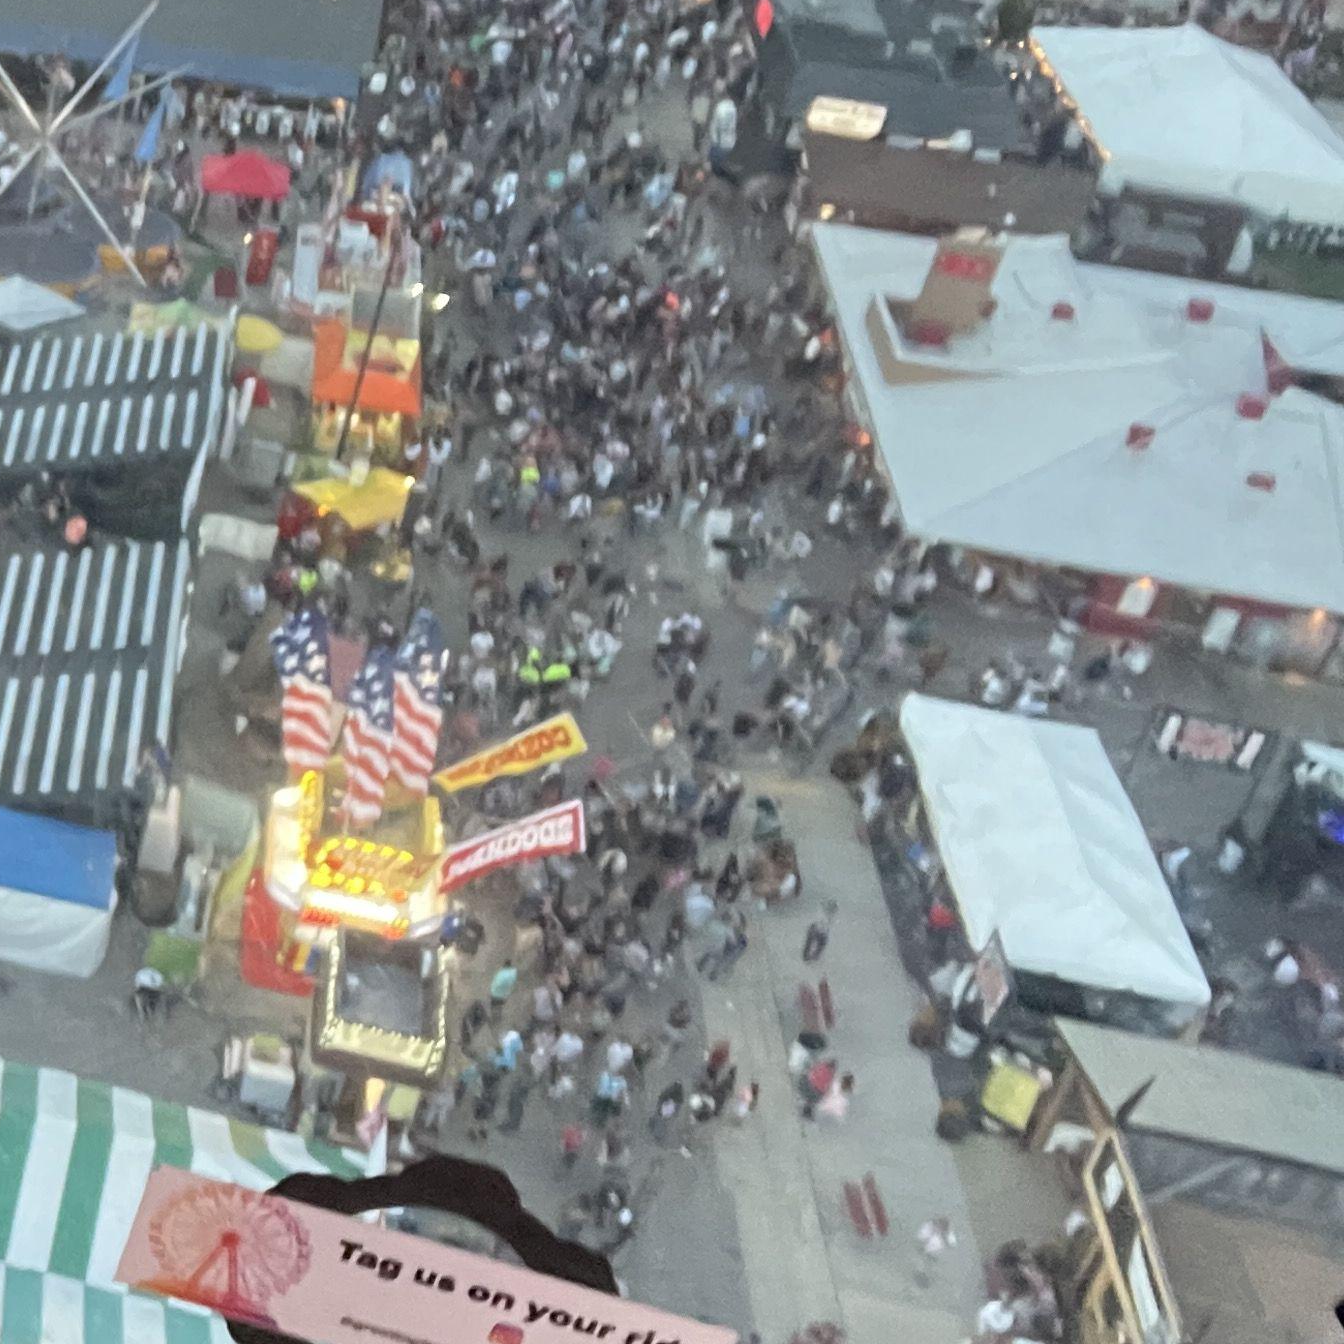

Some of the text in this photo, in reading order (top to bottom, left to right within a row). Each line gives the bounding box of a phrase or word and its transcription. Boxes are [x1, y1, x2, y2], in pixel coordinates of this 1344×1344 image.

[338, 1238, 402, 1281] Tag
[413, 1268, 455, 1292] us
[467, 1285, 515, 1311] on
[525, 1302, 616, 1339] your
